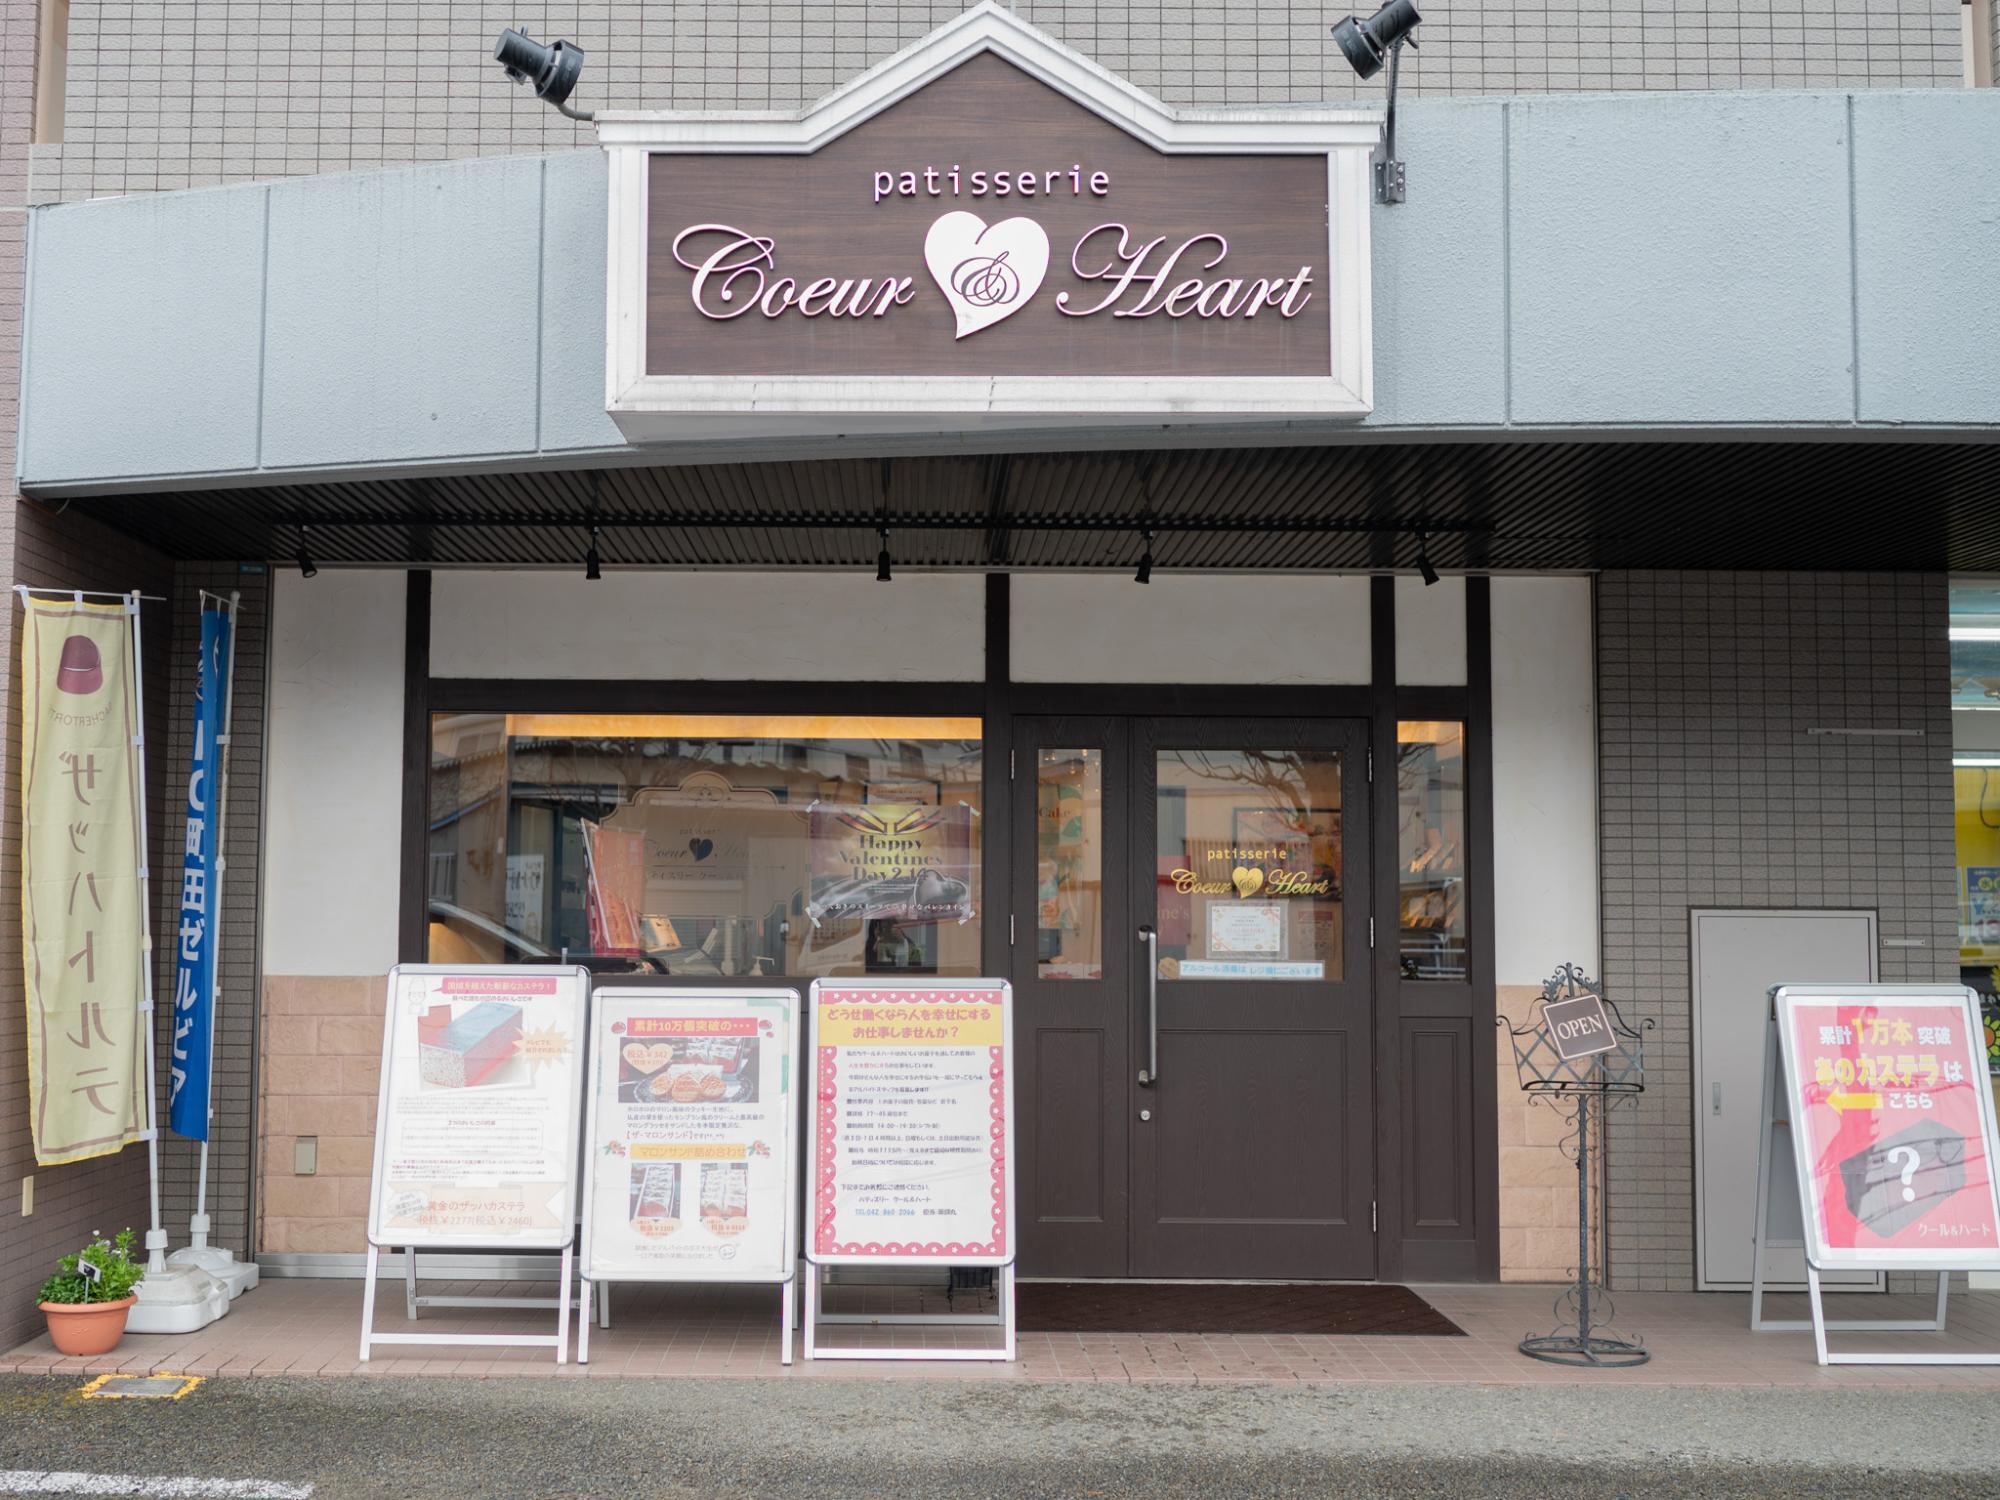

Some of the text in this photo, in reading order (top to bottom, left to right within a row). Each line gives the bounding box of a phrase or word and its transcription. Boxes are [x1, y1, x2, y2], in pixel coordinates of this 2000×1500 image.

[873, 164, 1110, 202] patisserie
[671, 222, 1313, 320] Coeur & Heart
[860, 834, 924, 852] Happy
[839, 850, 943, 866] Valentines
[1207, 848, 1287, 861] patisserie
[1171, 868, 1231, 895] Coeur
[1265, 868, 1329, 895] Heart
[827, 1008, 992, 1022] どうせ働くなら人を幸せにする
[1557, 1014, 1604, 1040] OPEN
[1814, 1052, 1964, 1087] あのカステラは
[1888, 1092, 1934, 1110] こちら
